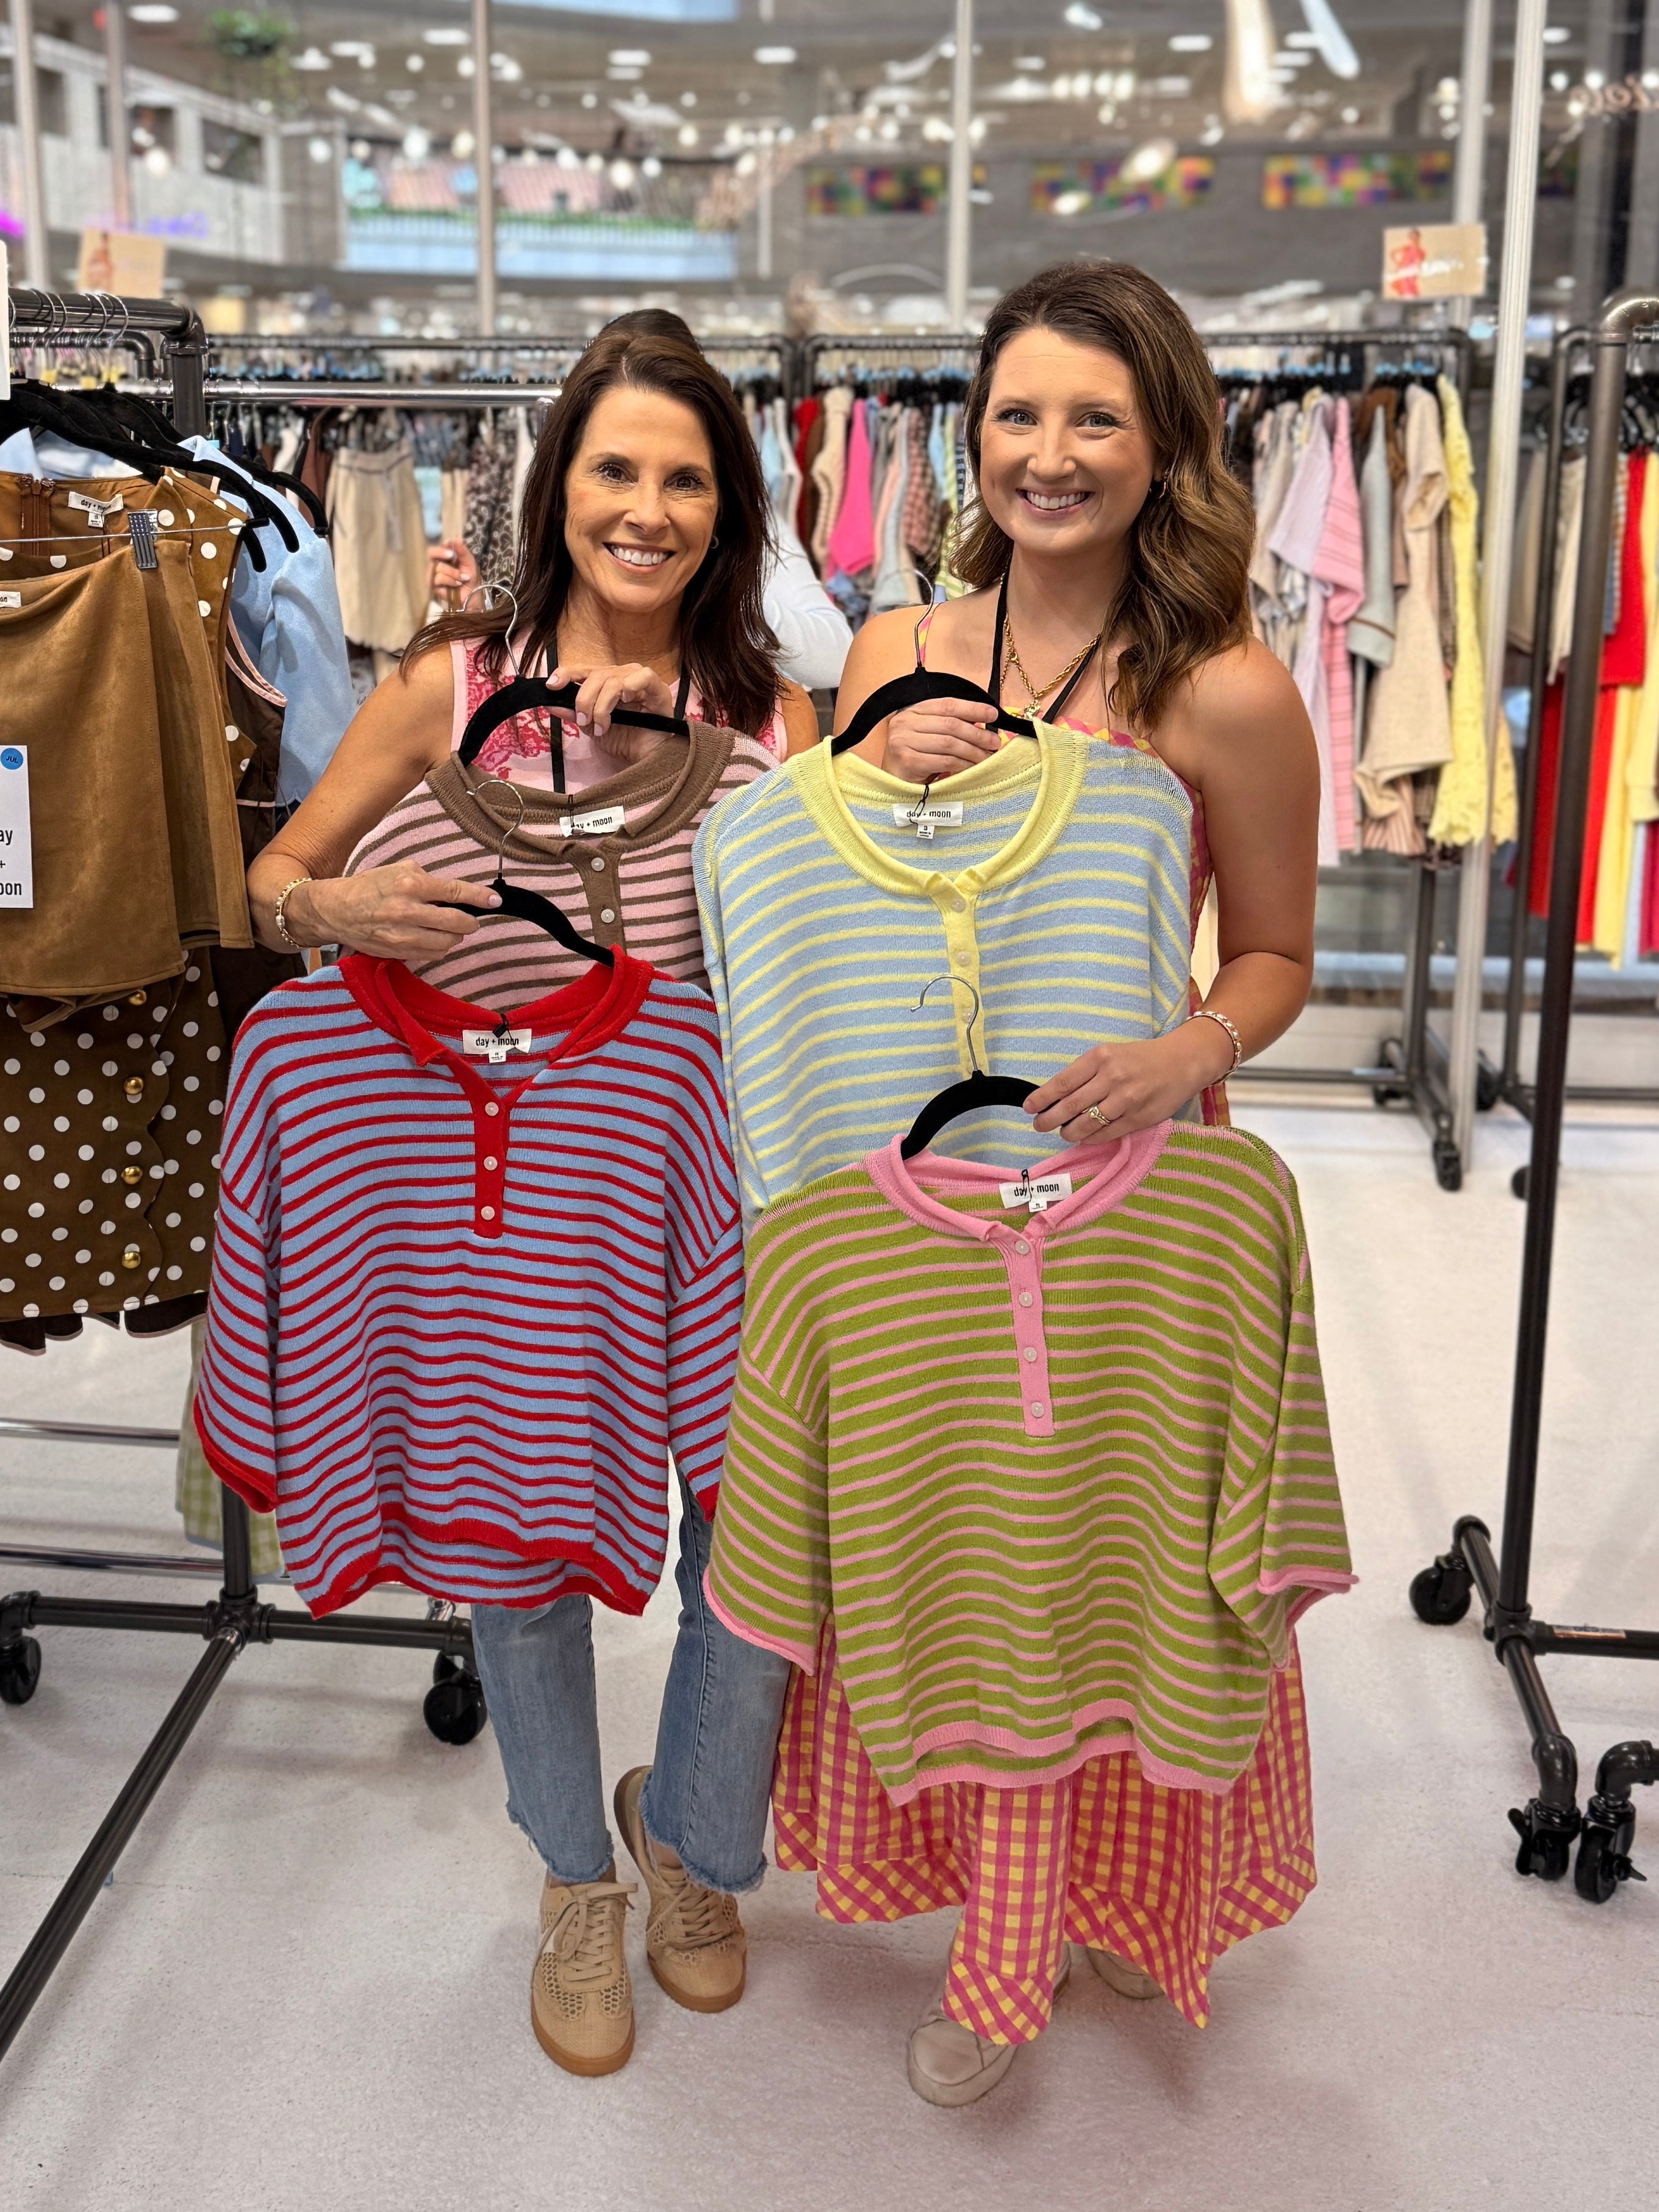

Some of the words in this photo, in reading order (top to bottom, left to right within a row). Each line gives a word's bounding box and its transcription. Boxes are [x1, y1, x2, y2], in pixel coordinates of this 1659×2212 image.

[81, 500, 91, 509] day
[593, 816, 612, 827] moon
[476, 1037, 489, 1048] day
[1014, 1187, 1027, 1197] day
[1037, 1183, 1059, 1193] moon
